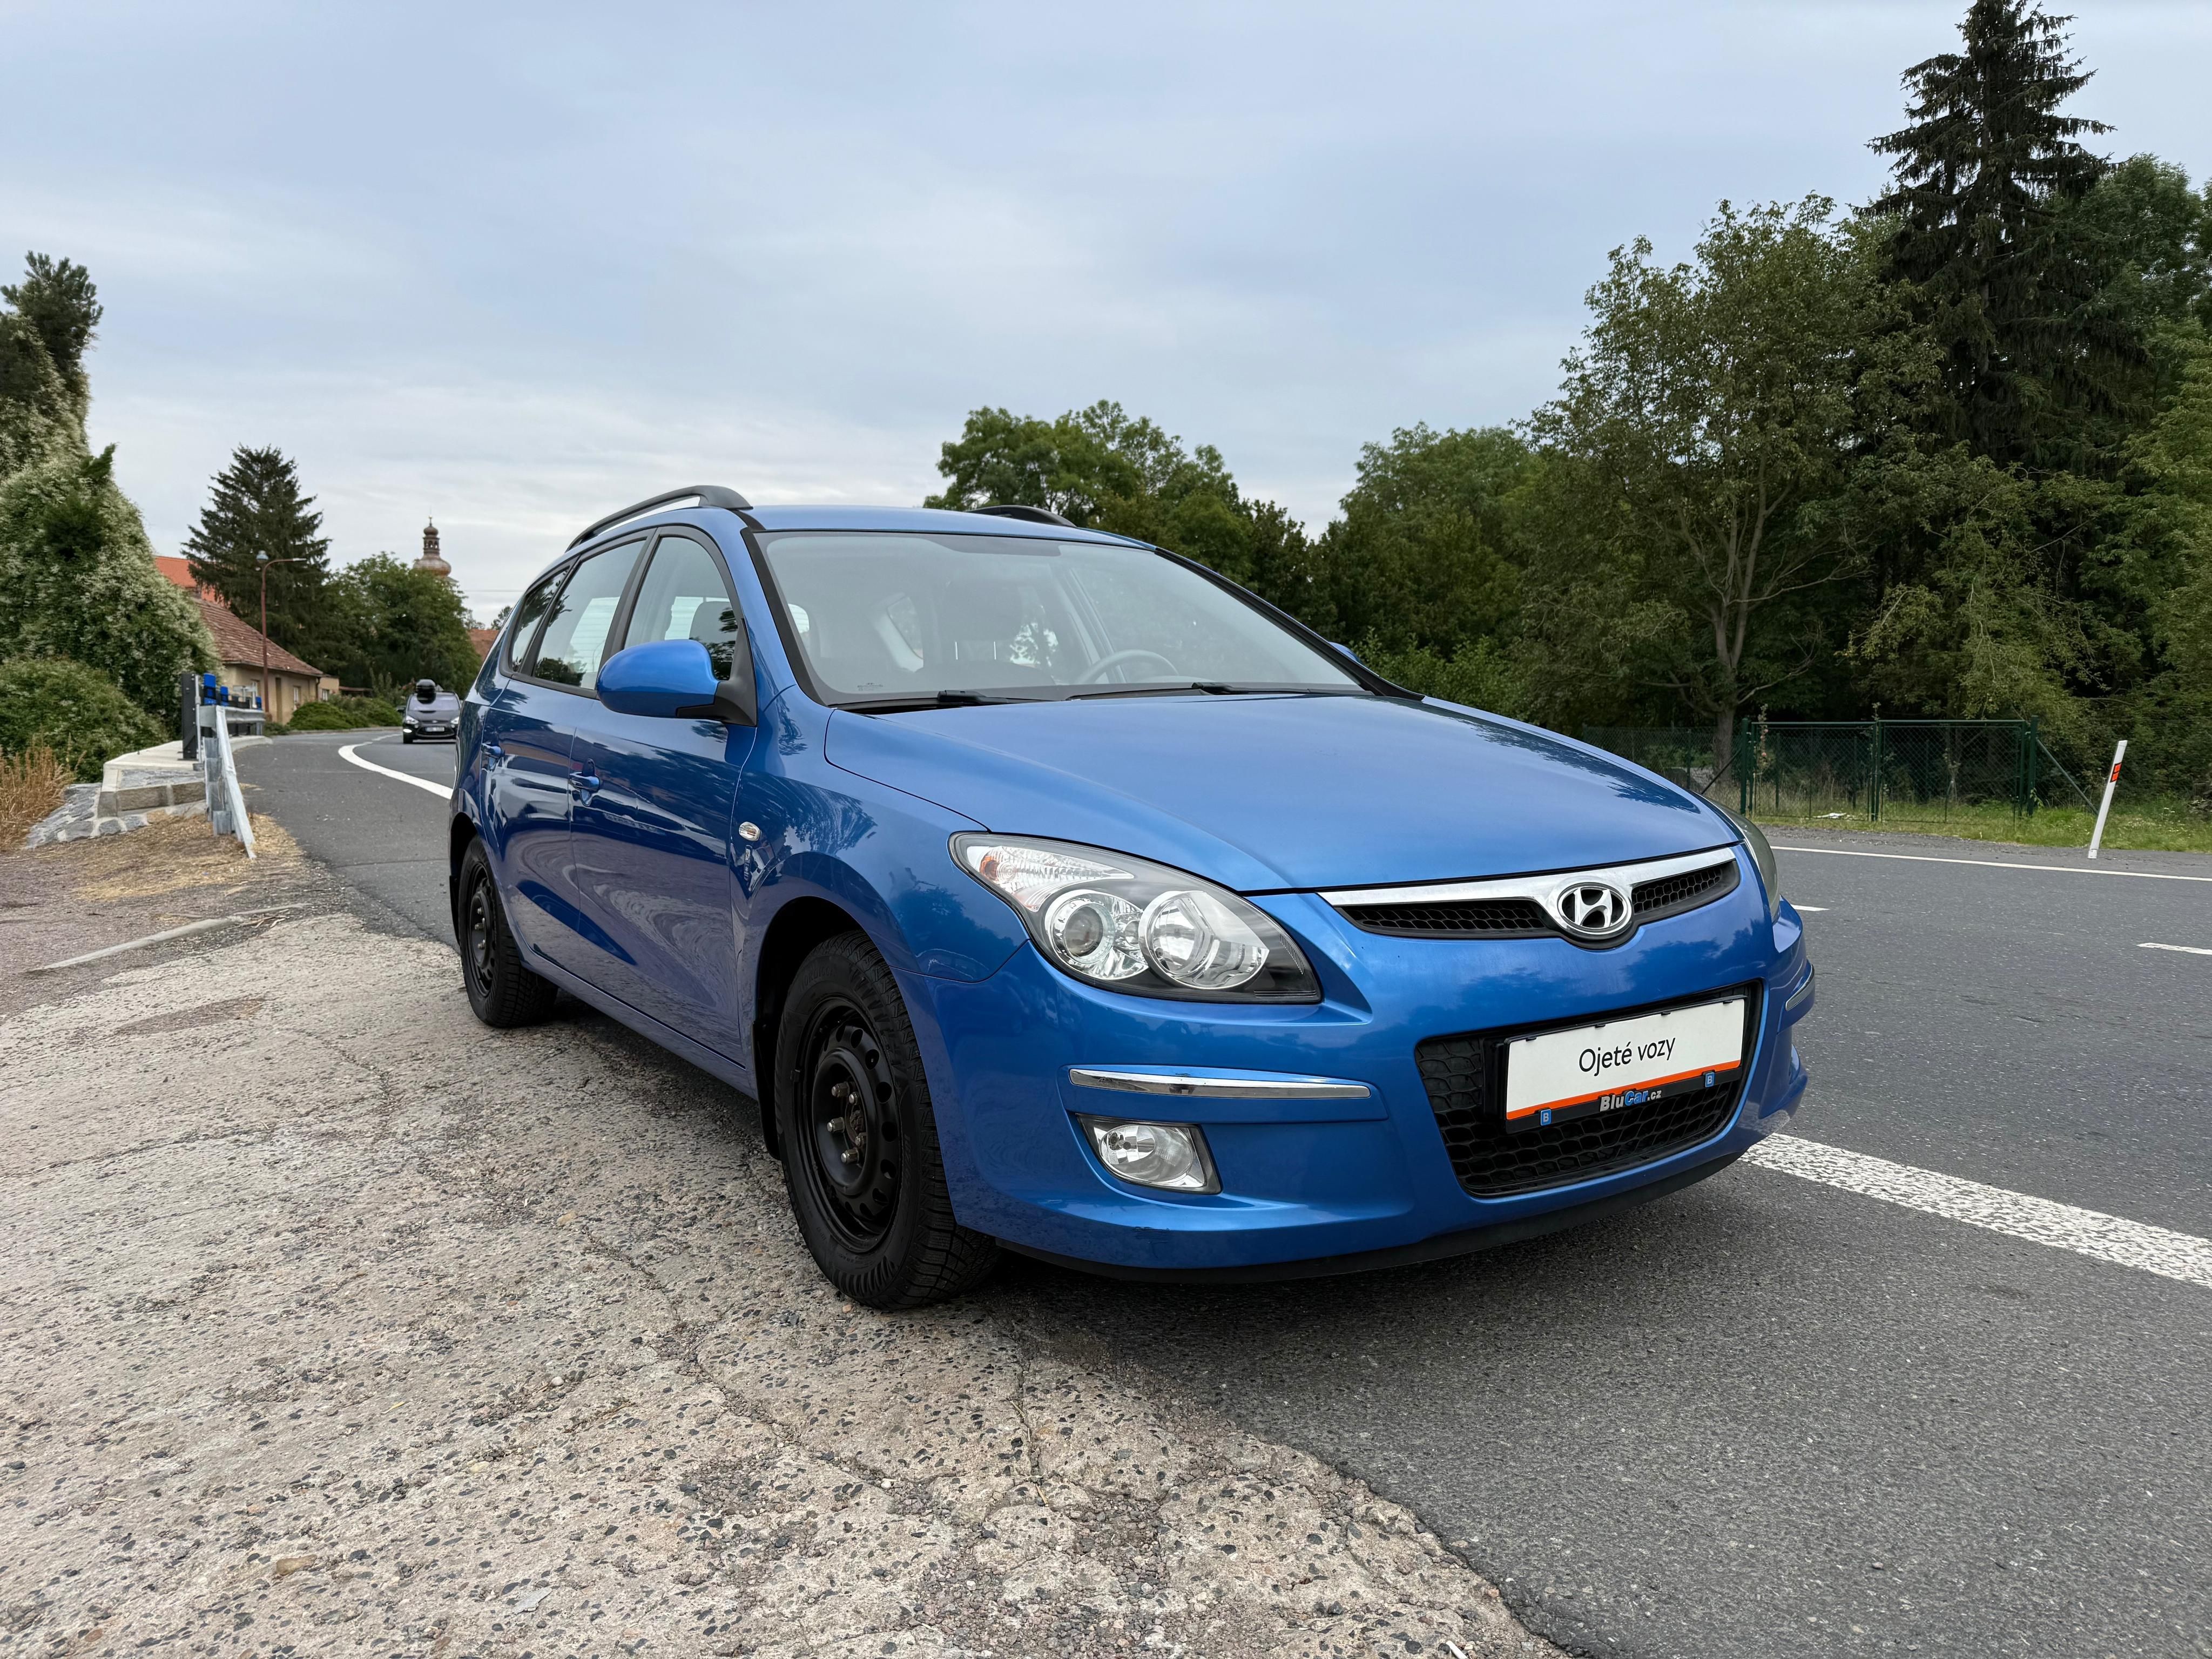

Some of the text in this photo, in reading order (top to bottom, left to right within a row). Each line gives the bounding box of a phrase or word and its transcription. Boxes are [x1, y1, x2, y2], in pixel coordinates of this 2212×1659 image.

[1579, 1037, 1676, 1076] Ojeté vozy
[1600, 1090, 1662, 1112] BluCar.cz
